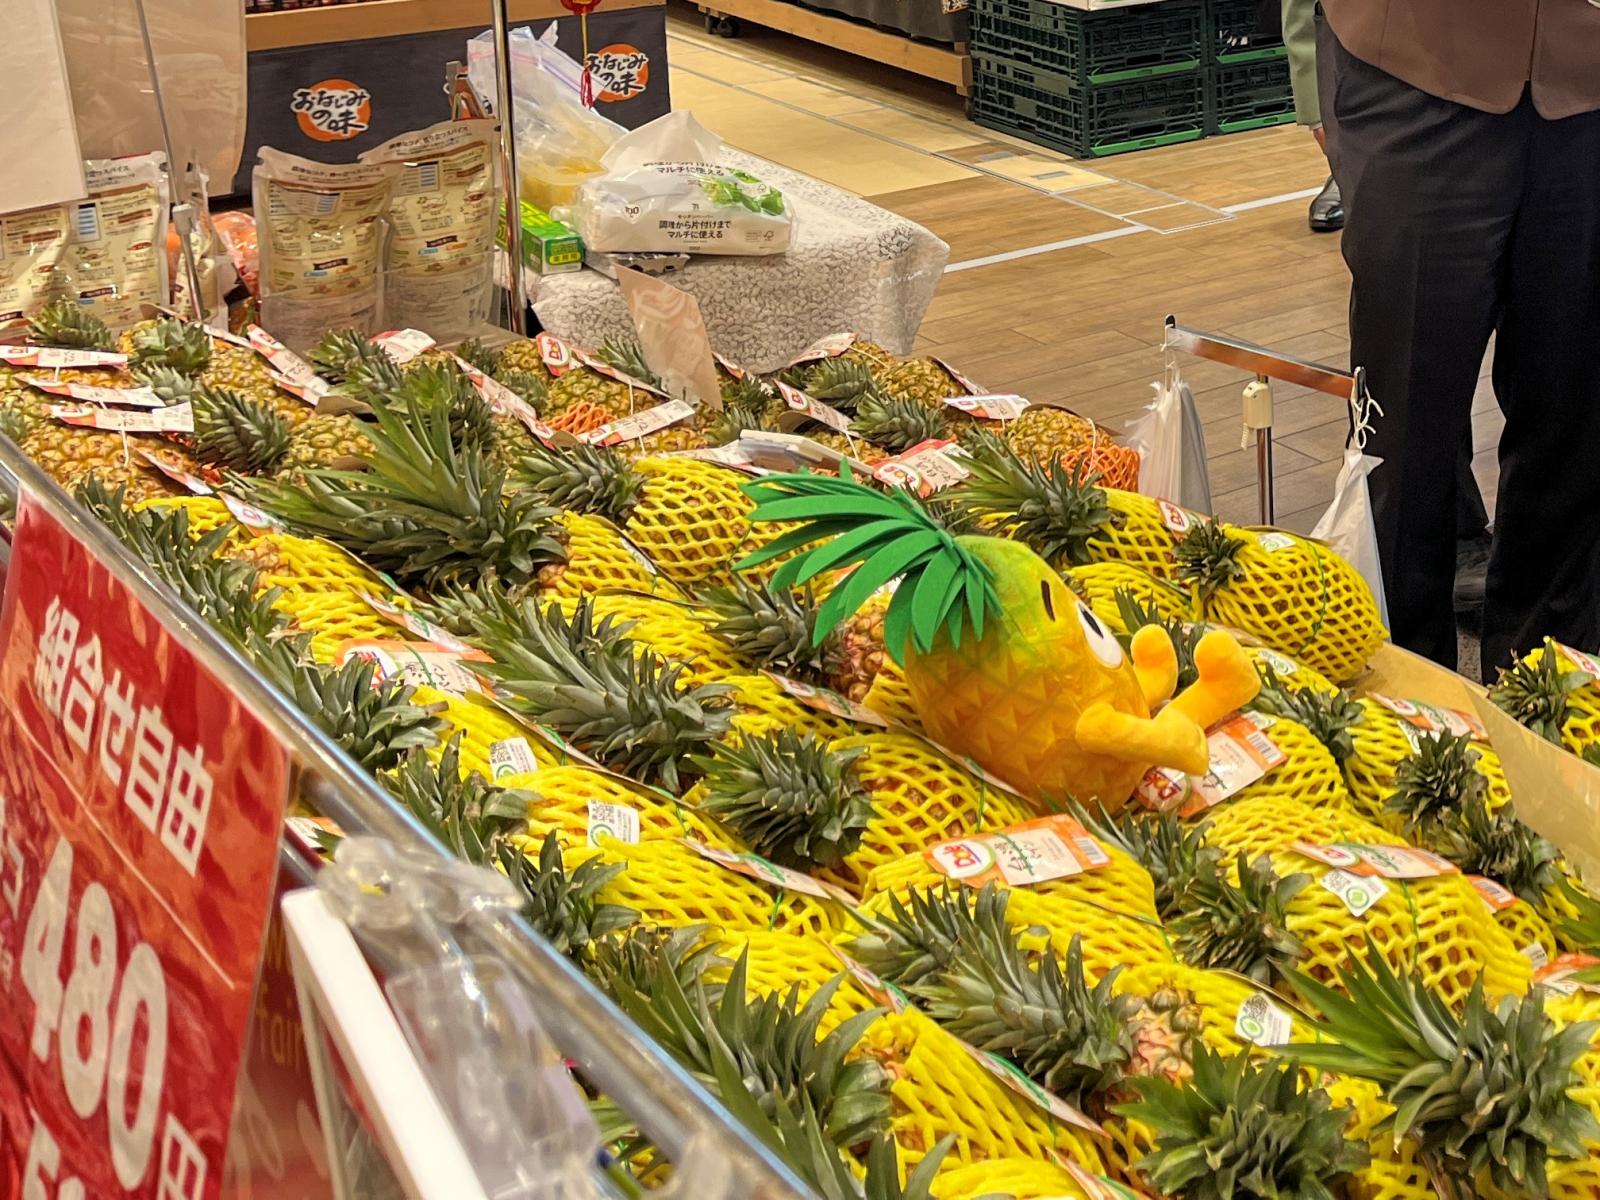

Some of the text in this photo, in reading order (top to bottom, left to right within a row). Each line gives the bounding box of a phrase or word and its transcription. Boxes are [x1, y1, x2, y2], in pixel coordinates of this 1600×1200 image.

[587, 52, 648, 76] おなじみ
[293, 88, 369, 112] おなじみ
[310, 107, 367, 134] の味
[667, 230, 723, 240] マルチに使える
[35, 597, 214, 878] 組合せ自由
